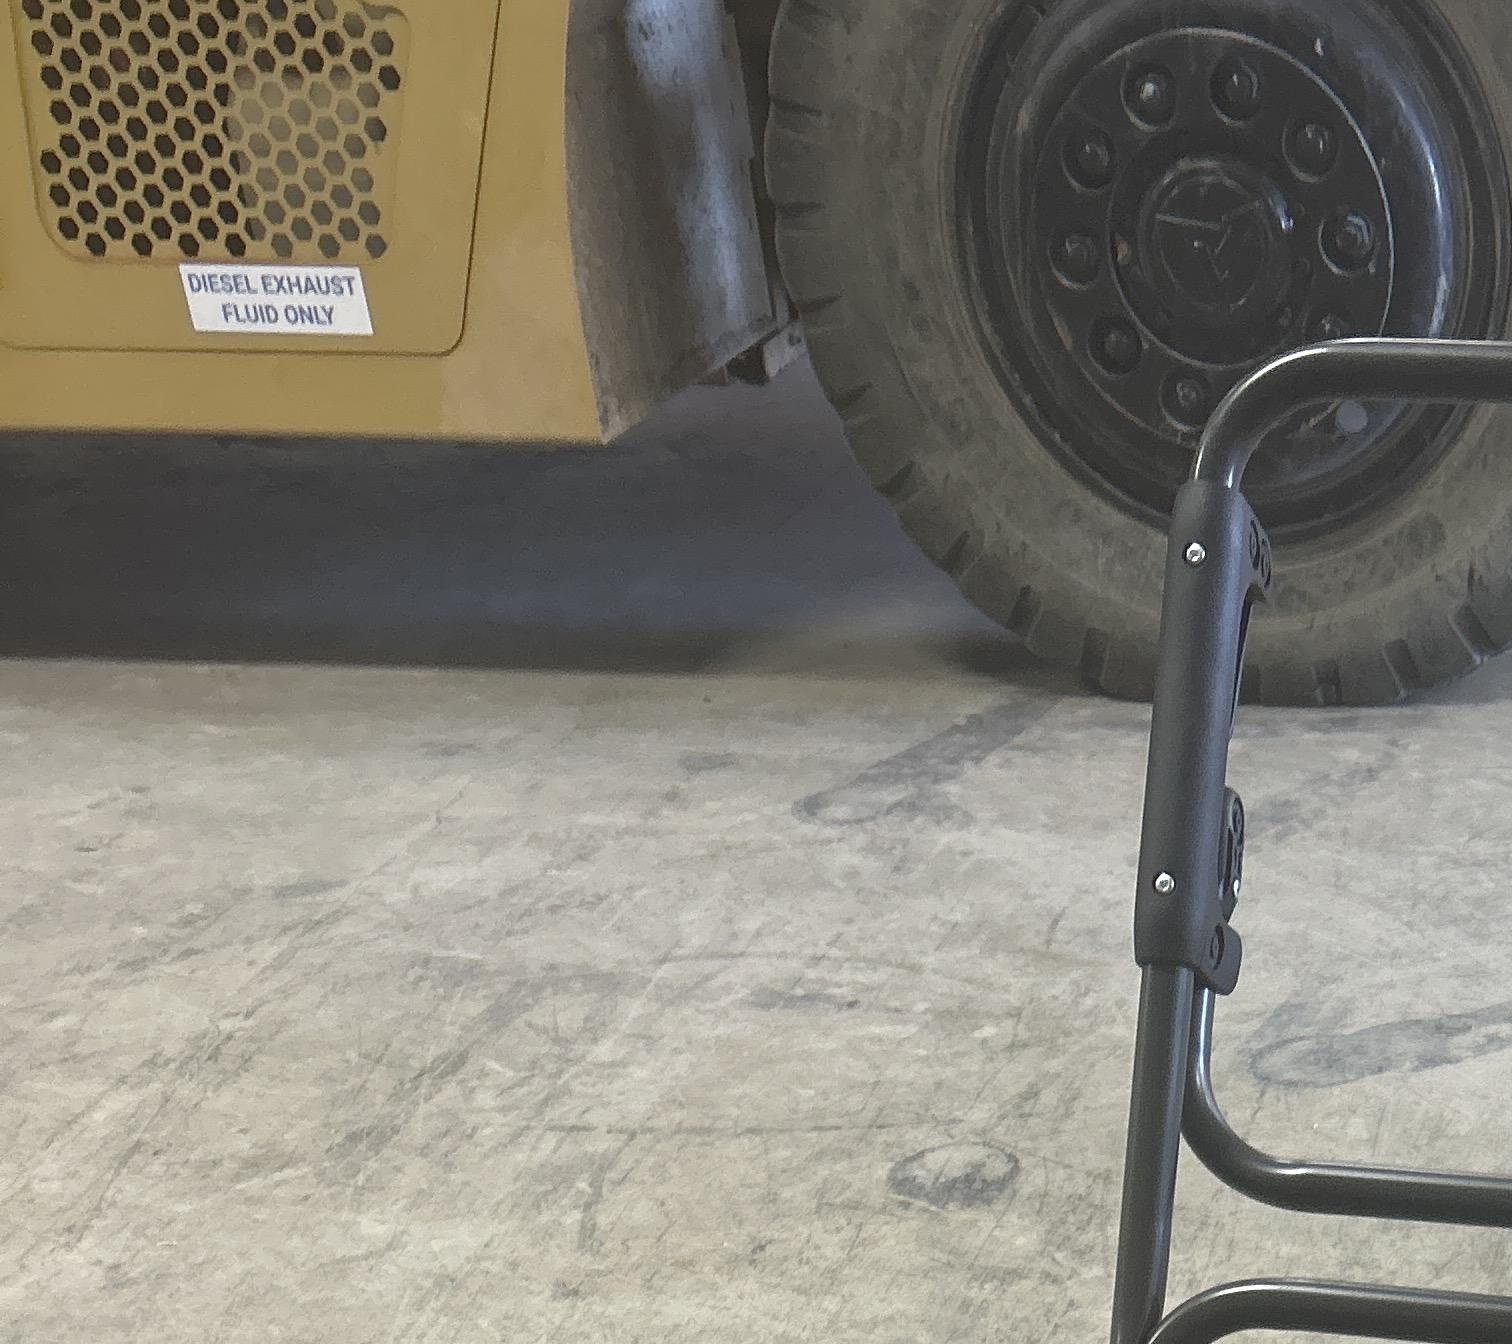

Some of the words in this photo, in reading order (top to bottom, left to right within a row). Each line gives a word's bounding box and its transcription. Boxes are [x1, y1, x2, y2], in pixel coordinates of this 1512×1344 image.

[187, 273, 258, 296] DIESEL
[261, 274, 356, 297] EXHAUST
[221, 302, 279, 325] FLUID
[284, 304, 335, 326] ONLY
